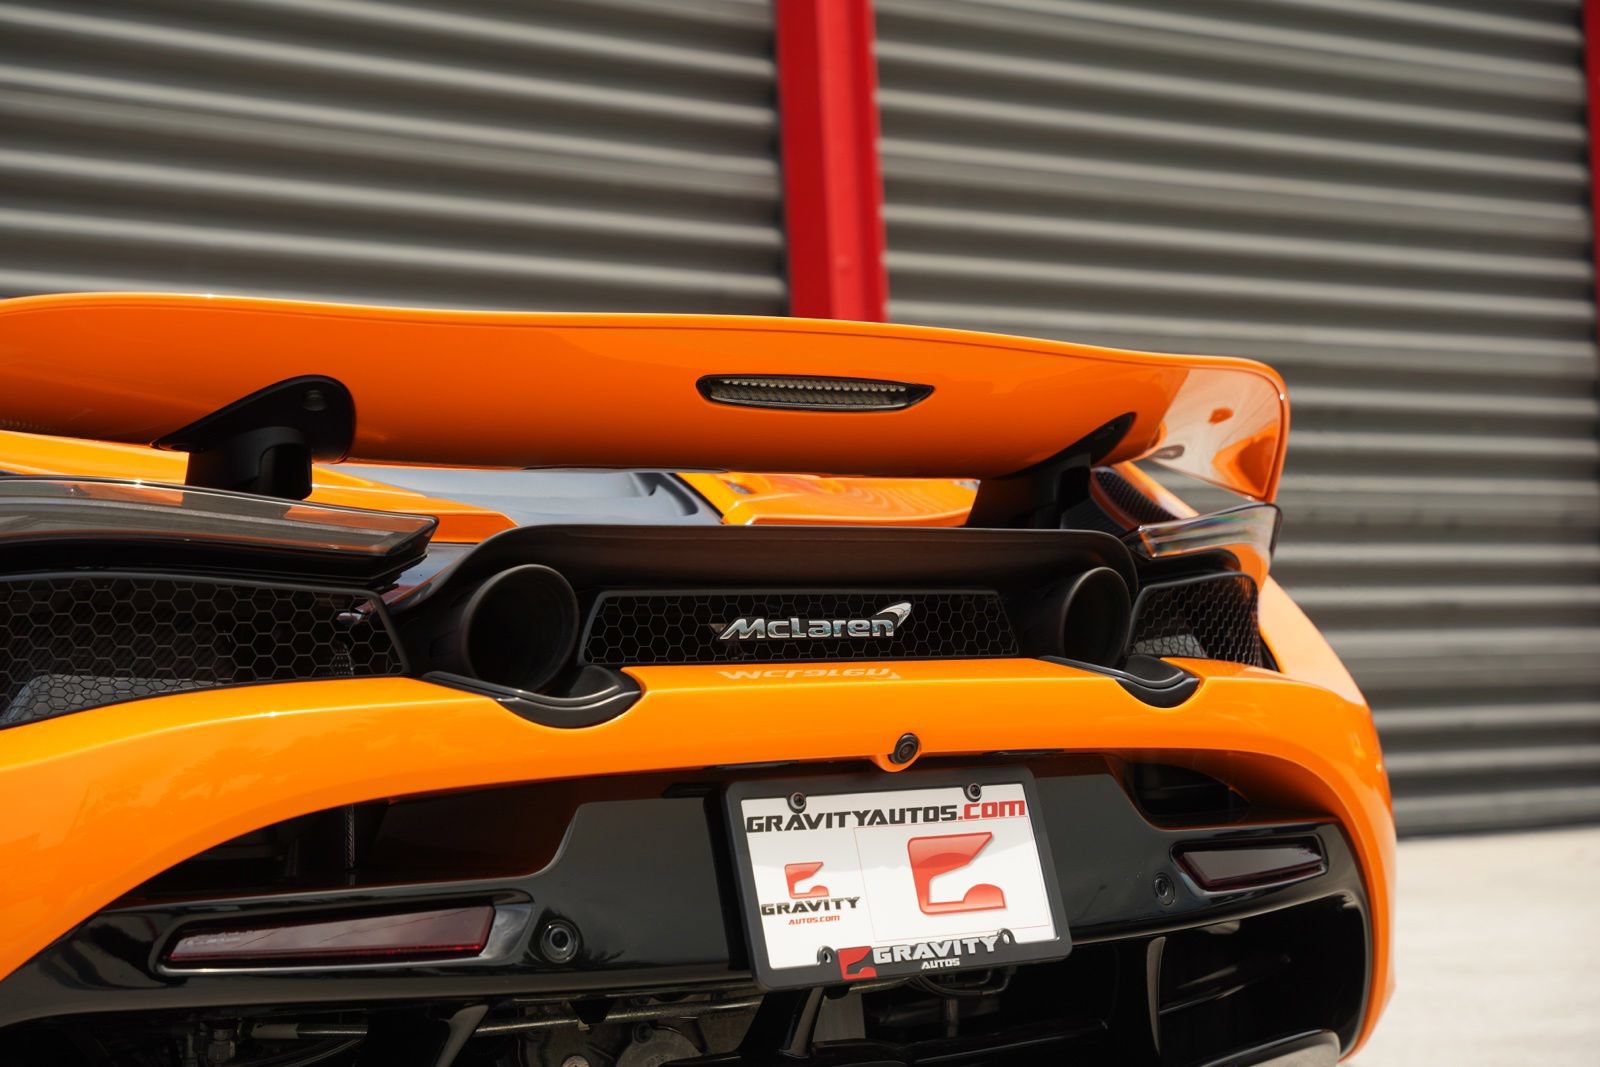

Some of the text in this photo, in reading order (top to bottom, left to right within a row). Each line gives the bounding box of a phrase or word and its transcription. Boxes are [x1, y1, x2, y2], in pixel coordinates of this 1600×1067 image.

[719, 617, 895, 640] McLaren
[761, 896, 860, 916] GRAVITY
[872, 935, 999, 964] GRAVITY
[921, 957, 960, 970] AUTOS
